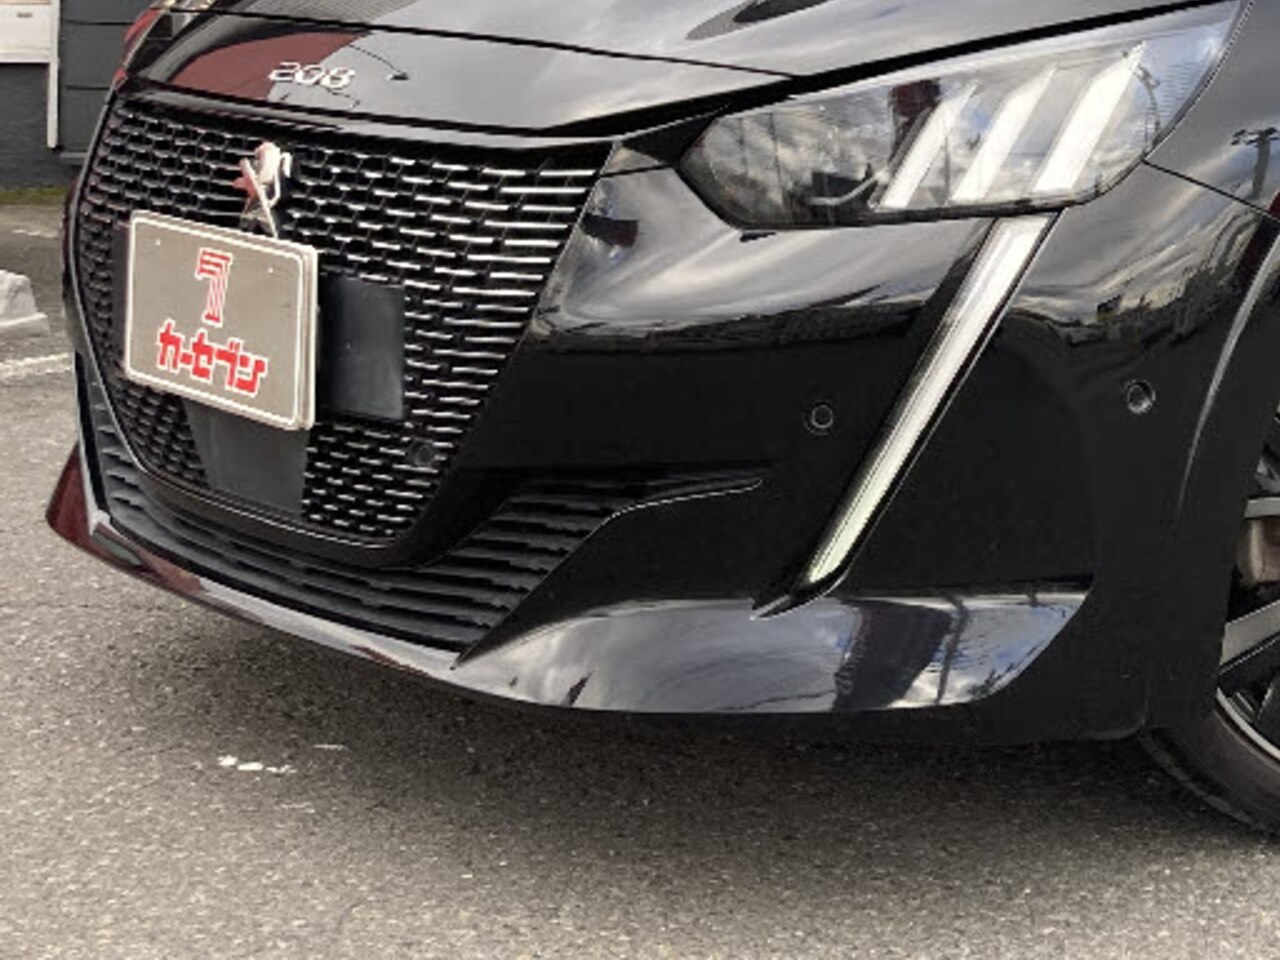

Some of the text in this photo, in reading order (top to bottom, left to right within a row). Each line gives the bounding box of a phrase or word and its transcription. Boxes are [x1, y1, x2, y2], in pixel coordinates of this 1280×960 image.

[267, 61, 356, 90] 208
[157, 318, 268, 397] カーセブン
